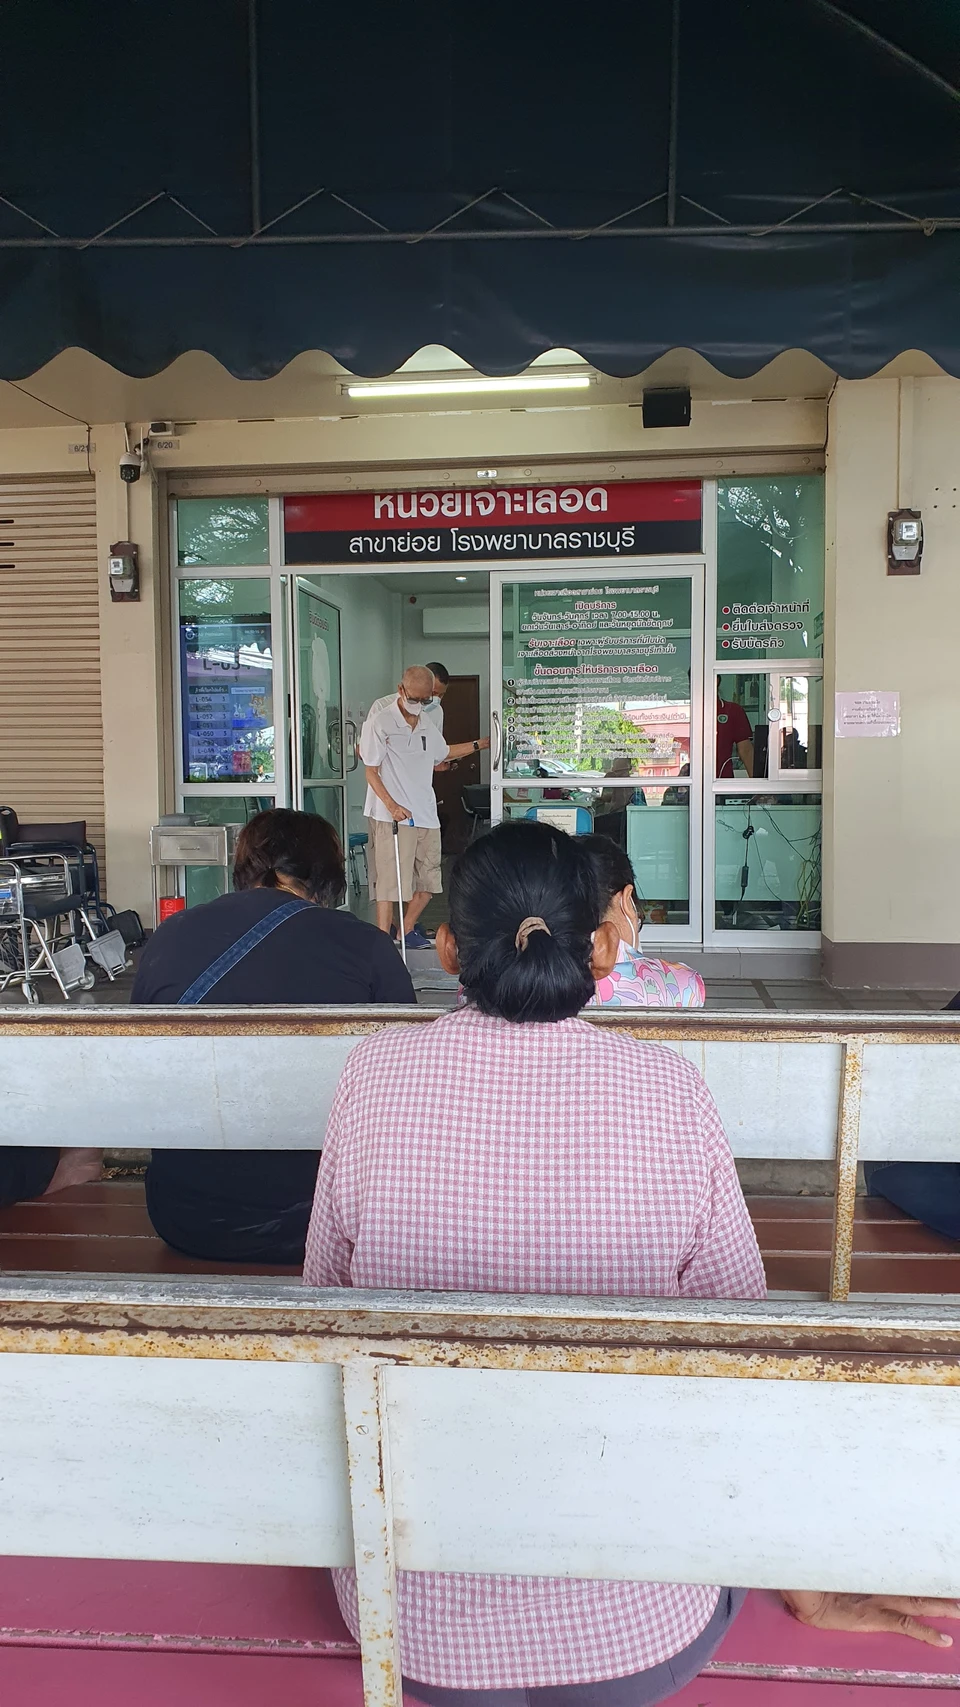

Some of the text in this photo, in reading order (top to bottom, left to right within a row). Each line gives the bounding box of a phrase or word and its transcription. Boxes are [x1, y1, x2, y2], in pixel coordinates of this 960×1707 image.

[157, 441, 174, 449] 6/20
[374, 487, 609, 519] หนวยเจาะเลอด
[349, 524, 635, 554] สาขาย่อย โรงพยาบาลราชบุรี
[575, 601, 617, 611] เปิดบริการ
[732, 599, 811, 614] ติดต่อเจ้าหน้าที่
[591, 612, 608, 620] เวลา
[732, 617, 804, 632] ยื่นใบส่งตรวจ
[732, 637, 785, 651] รับบัตรคิว
[534, 663, 659, 676] ขั้นตอนการให้บริการเจาะเลือด
